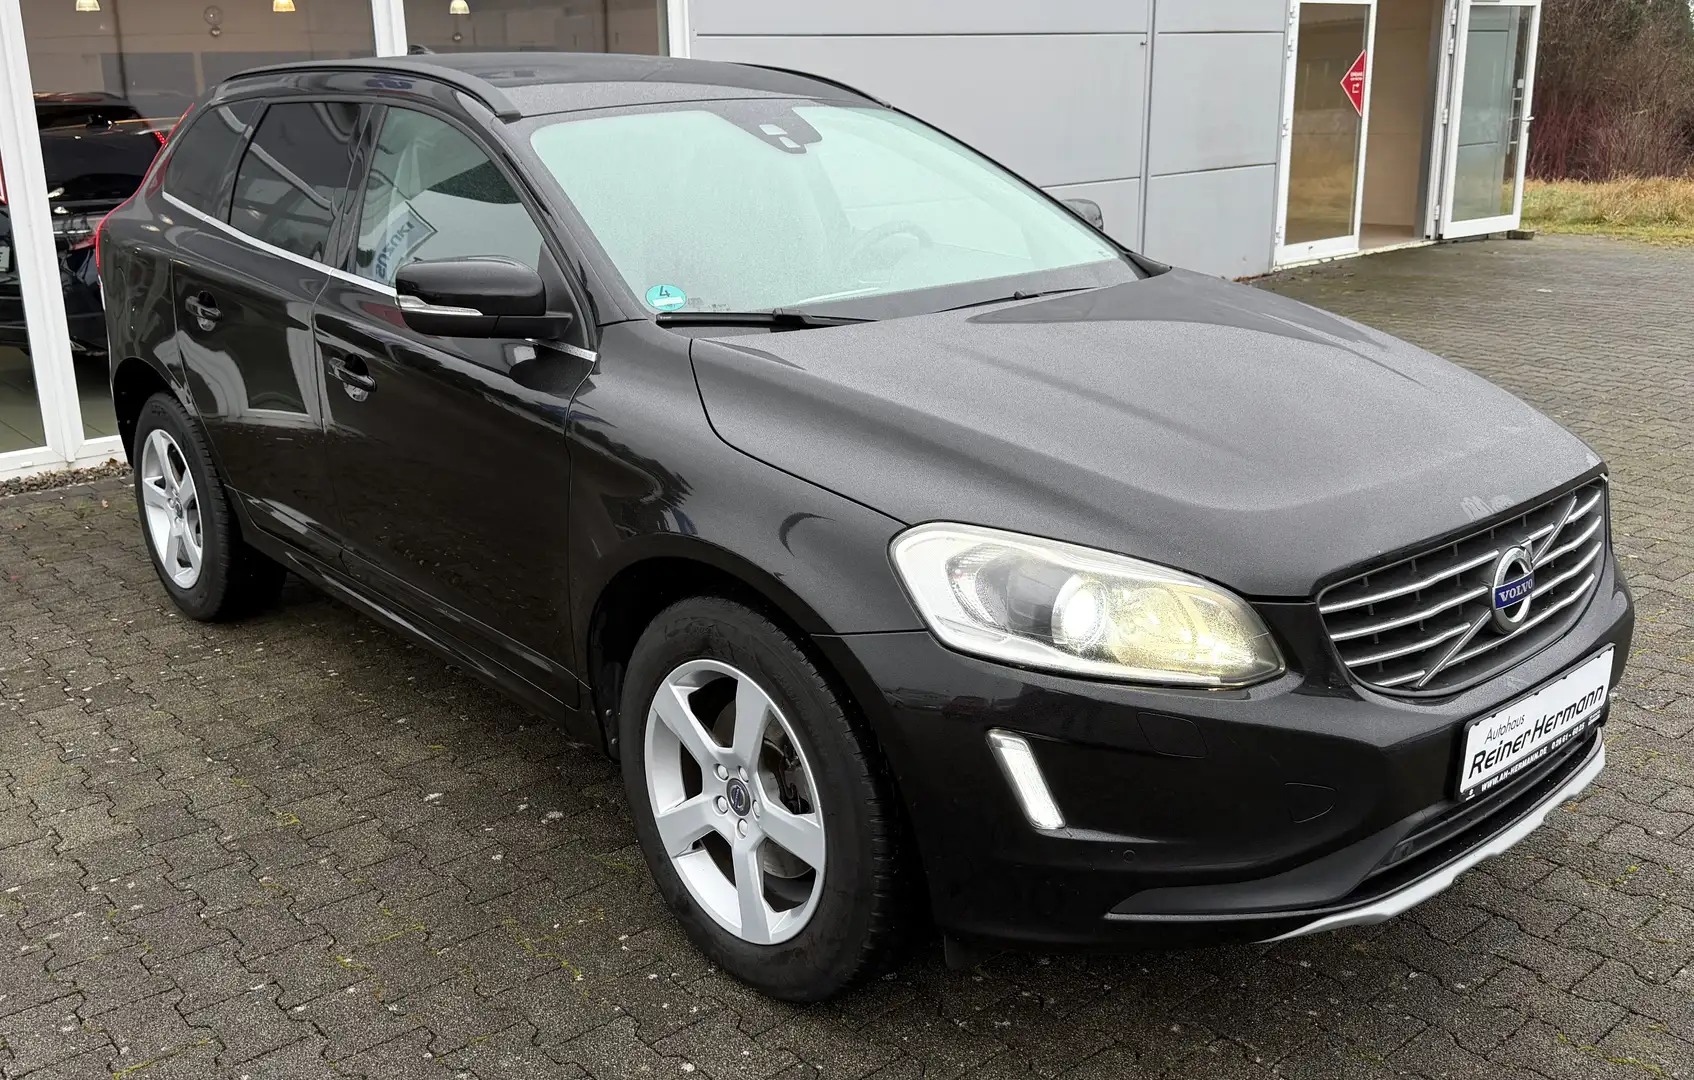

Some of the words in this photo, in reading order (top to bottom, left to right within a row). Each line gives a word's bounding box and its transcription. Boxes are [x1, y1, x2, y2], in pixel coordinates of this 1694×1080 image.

[659, 286, 670, 297] 4
[1498, 578, 1533, 602] VOLVO
[1468, 728, 1531, 780] Reiner
[1530, 685, 1604, 743] Hermann
[1484, 714, 1525, 744] Autohaus
